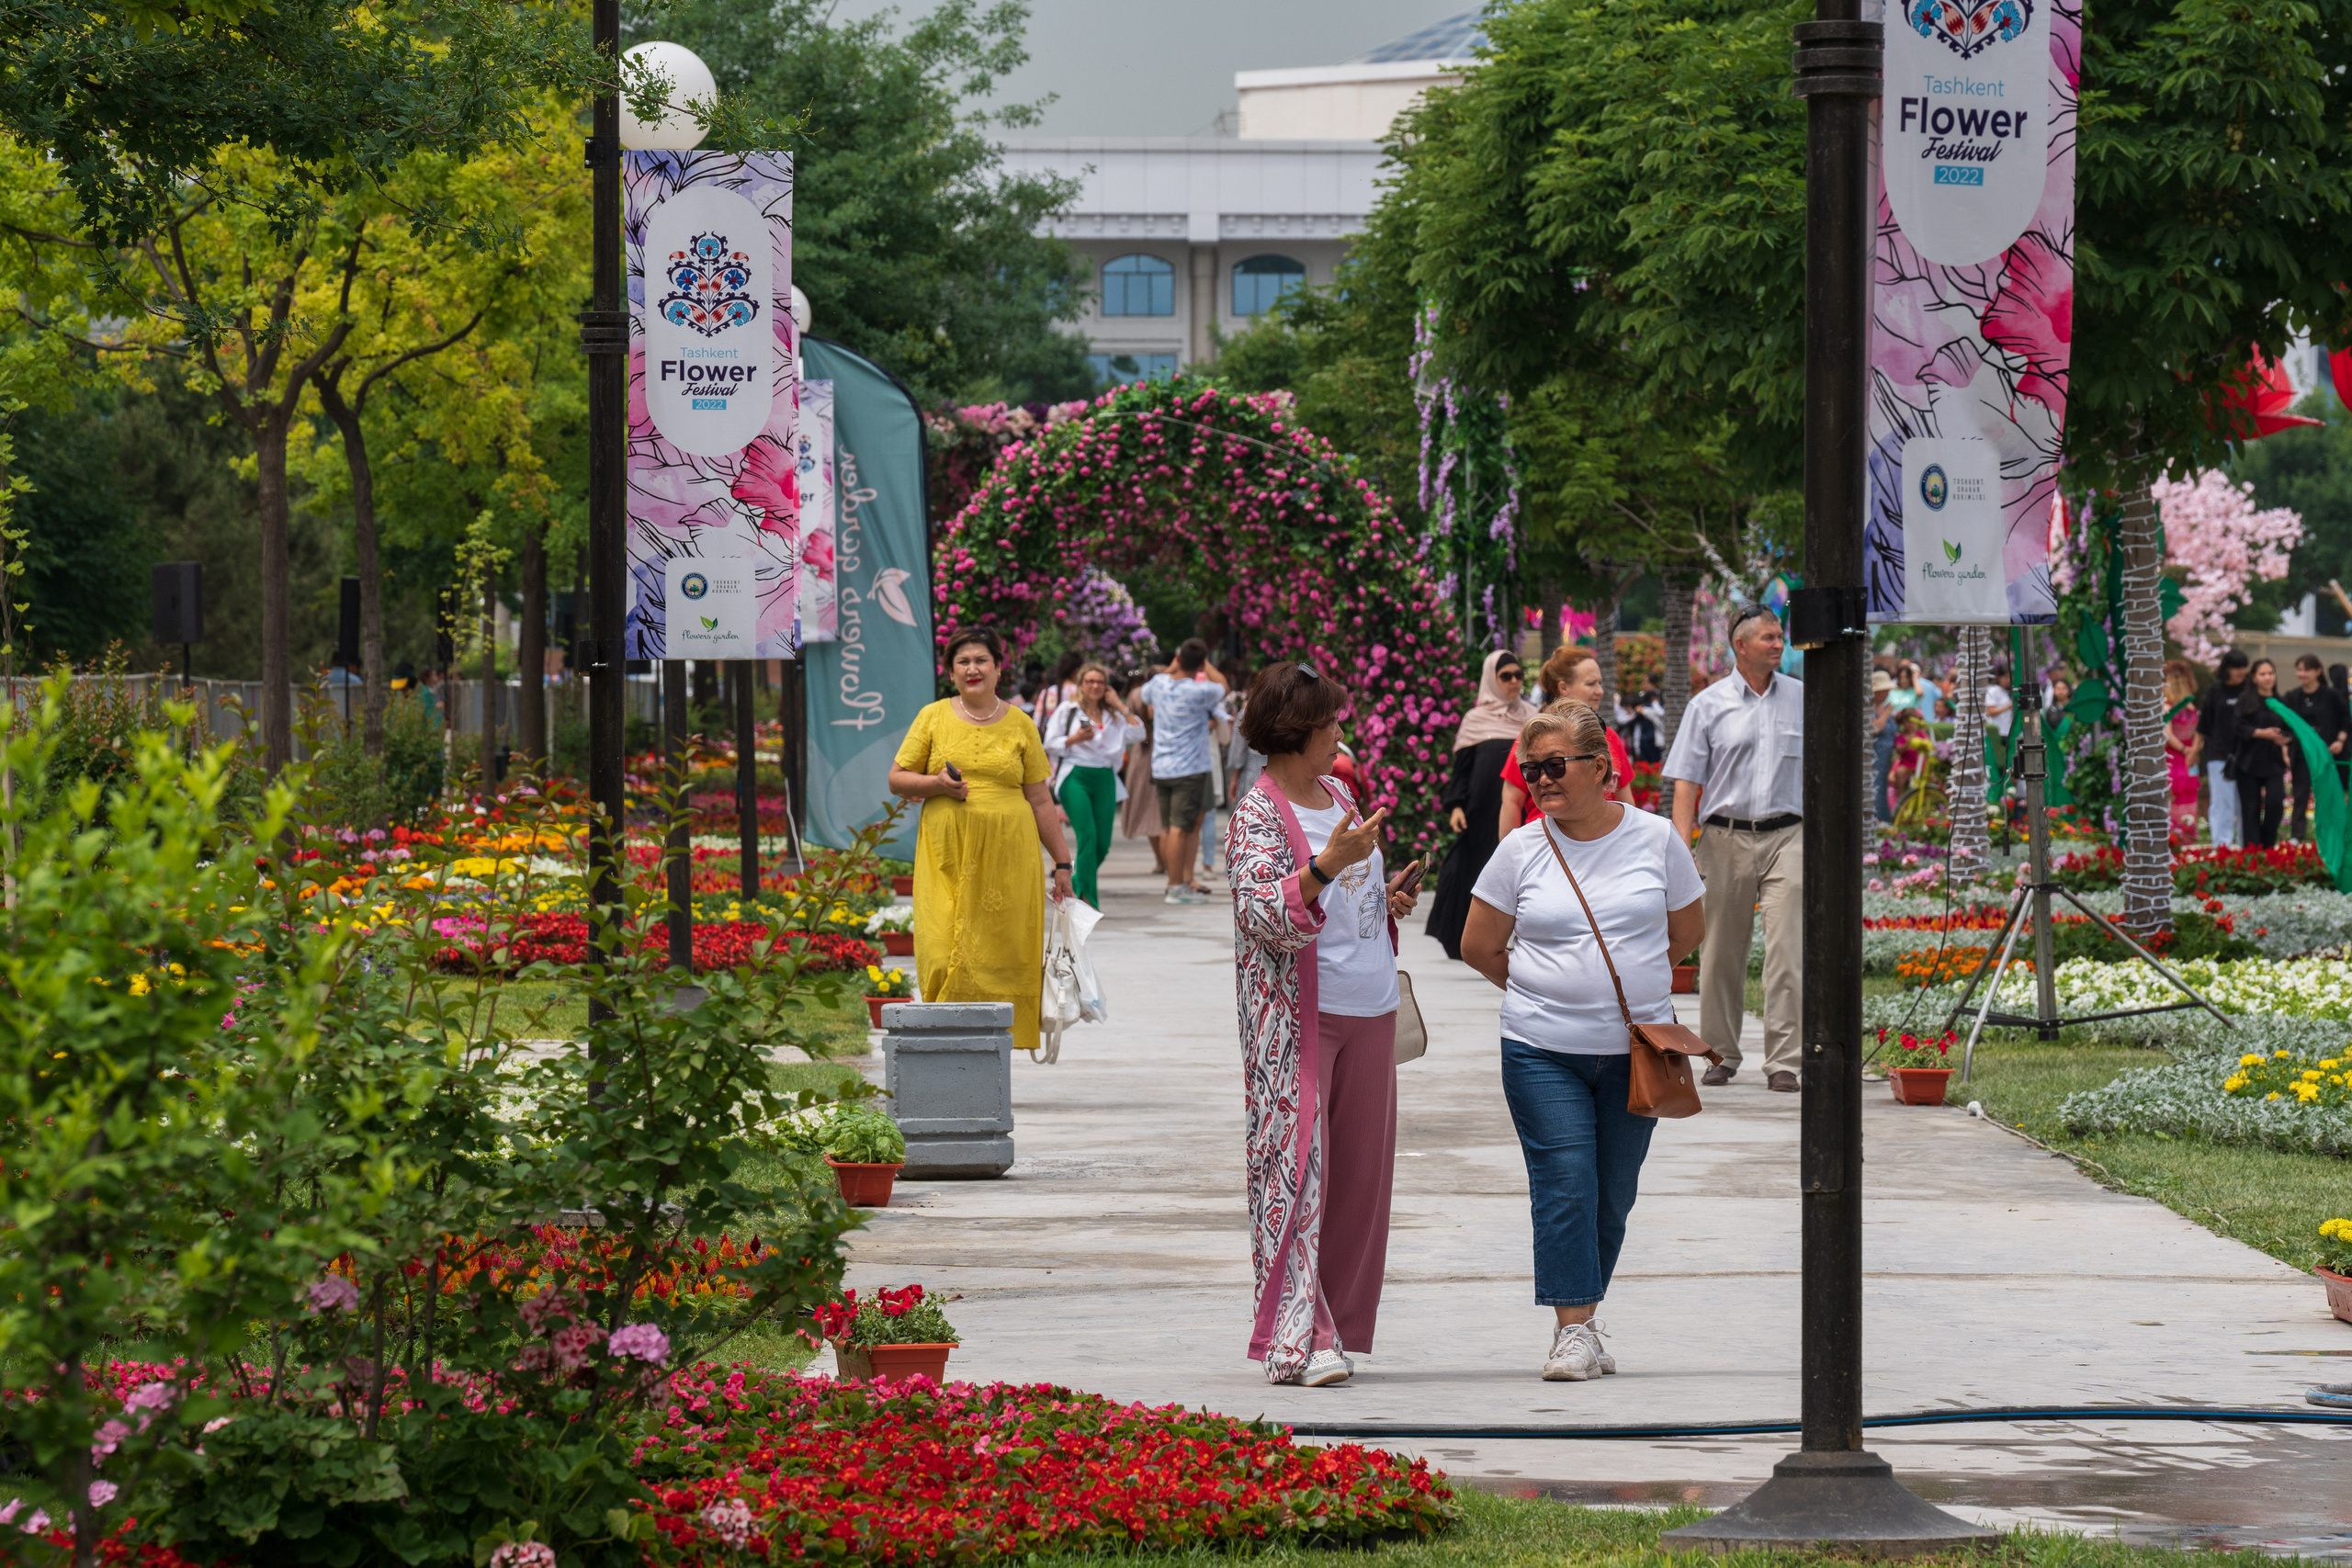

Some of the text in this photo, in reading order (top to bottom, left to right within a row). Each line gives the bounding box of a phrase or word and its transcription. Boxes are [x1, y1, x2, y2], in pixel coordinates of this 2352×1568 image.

[1924, 75, 2005, 97] Tashkent
[1900, 96, 2028, 139] Flower
[1921, 137, 2003, 163] Festival
[1939, 167, 1980, 185] 2022
[680, 346, 739, 359] Tashkent
[661, 360, 757, 382] Flower
[681, 382, 740, 398] Festival
[695, 399, 724, 410] 2022
[1922, 562, 1987, 586] flowers garden
[682, 629, 740, 644] flowers garden
